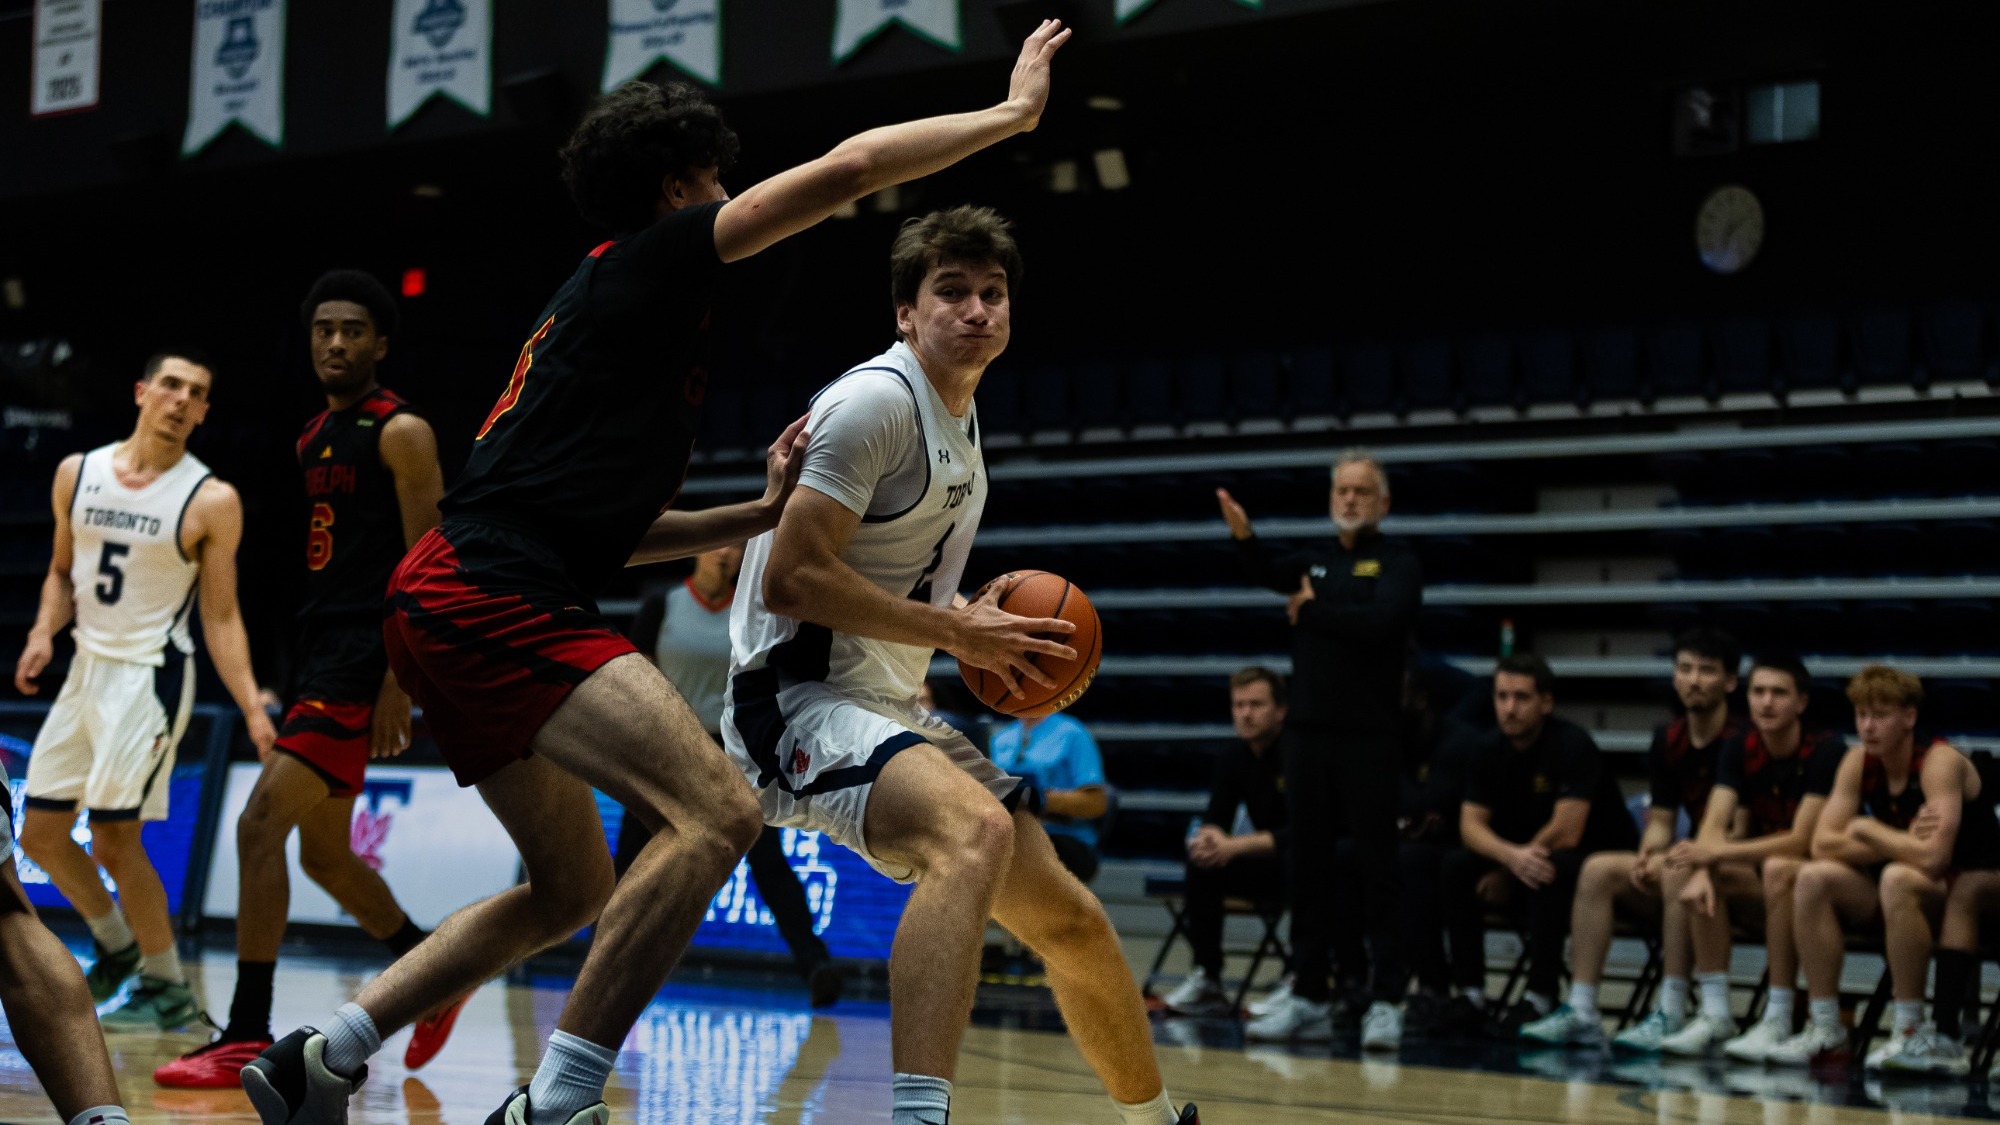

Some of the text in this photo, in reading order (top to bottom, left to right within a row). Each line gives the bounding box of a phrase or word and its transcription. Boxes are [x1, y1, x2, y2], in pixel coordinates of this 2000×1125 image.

[84, 507, 161, 536] TORONTO
[306, 501, 335, 571] 6
[96, 542, 129, 604] 5
